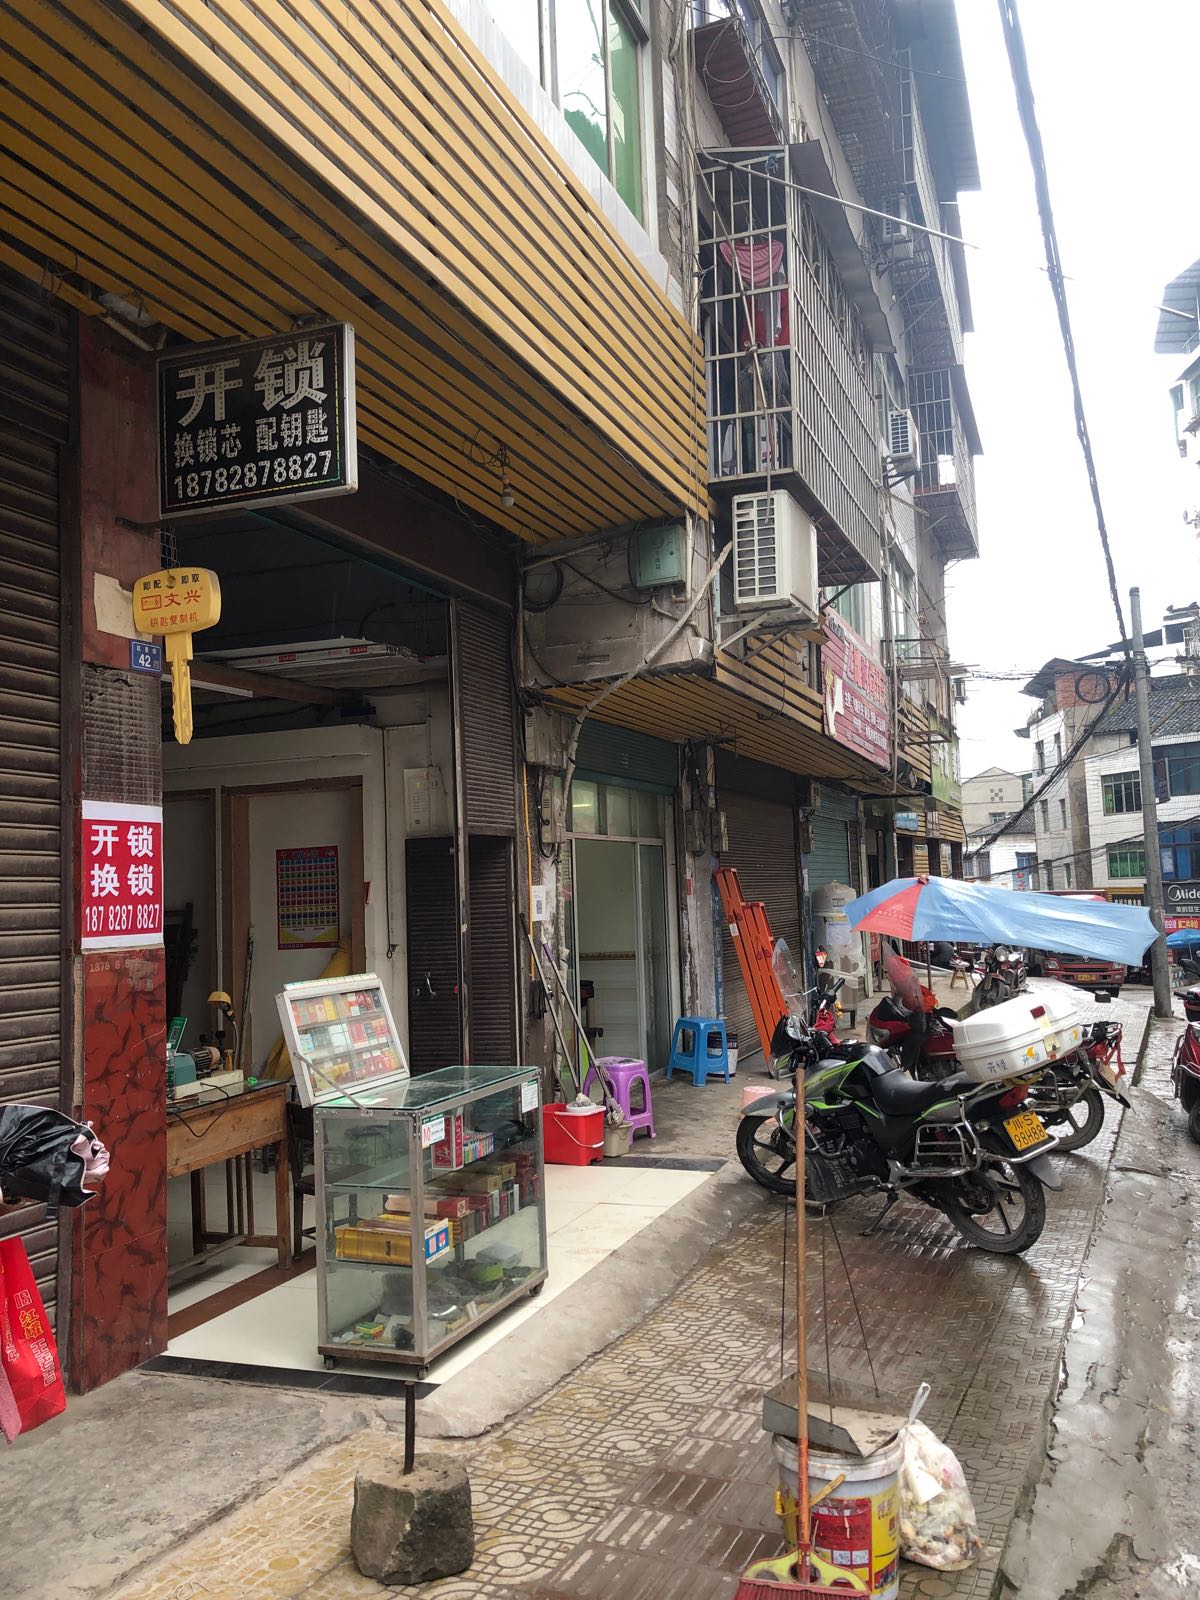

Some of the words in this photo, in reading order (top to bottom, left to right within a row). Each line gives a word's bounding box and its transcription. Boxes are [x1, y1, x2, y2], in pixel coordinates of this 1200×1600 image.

[176, 340, 328, 427] 开锁
[174, 423, 242, 468] 换锁芯
[255, 407, 329, 453] 配钥匙
[174, 451, 332, 499] 18782878827
[164, 589, 201, 607] 文兴
[138, 654, 151, 667] 42
[90, 824, 154, 858] 开锁
[90, 863, 154, 898] 换锁
[85, 906, 104, 932] 187
[108, 905, 133, 931] 8287
[136, 904, 160, 929] 8827
[1014, 1124, 1045, 1147] 98H88
